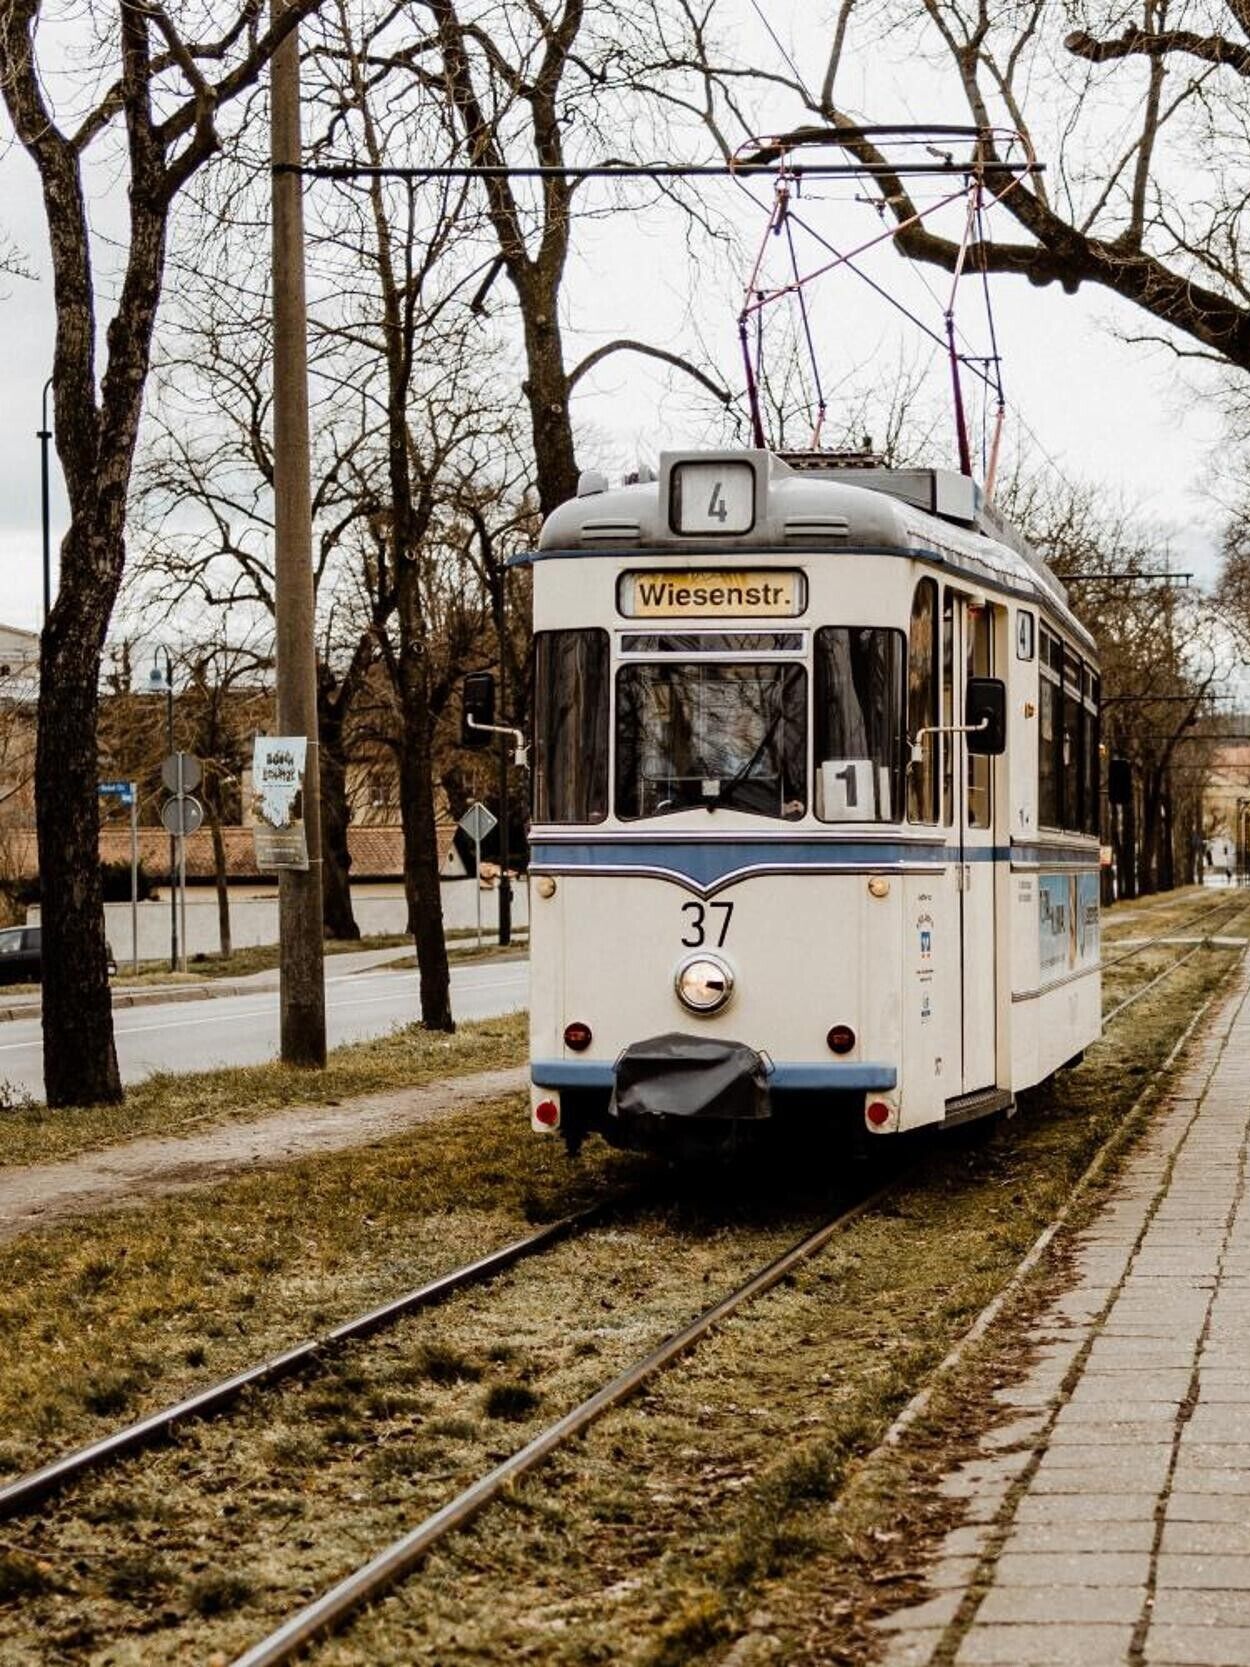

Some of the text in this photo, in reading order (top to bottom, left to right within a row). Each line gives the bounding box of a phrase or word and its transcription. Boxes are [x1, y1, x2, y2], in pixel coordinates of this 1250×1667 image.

[707, 481, 728, 523] 4
[639, 583, 791, 607] Wiesenstr.
[1019, 617, 1026, 651] 4
[835, 764, 858, 808] 1
[681, 901, 734, 948] 37
